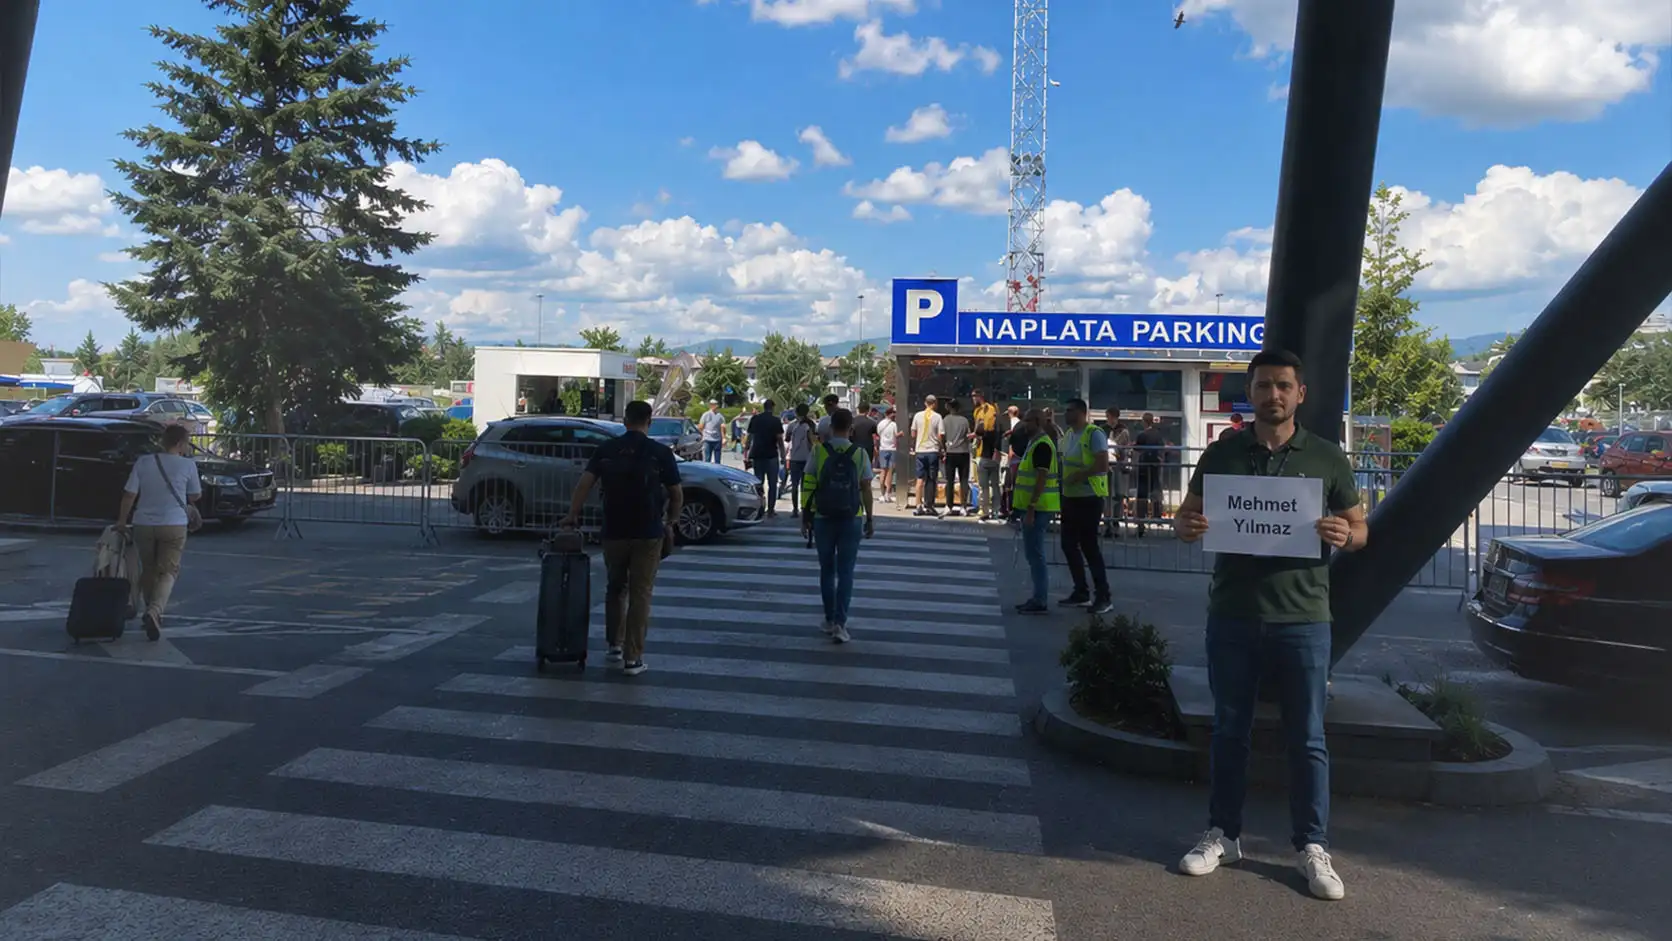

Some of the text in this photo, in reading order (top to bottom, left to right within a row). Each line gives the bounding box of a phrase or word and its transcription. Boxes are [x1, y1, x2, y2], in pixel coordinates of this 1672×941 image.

[905, 289, 944, 335] P
[975, 318, 1265, 345] NAPLATA PARKING
[1228, 495, 1297, 512] Mehmet
[1233, 518, 1291, 536] Yılmaz
